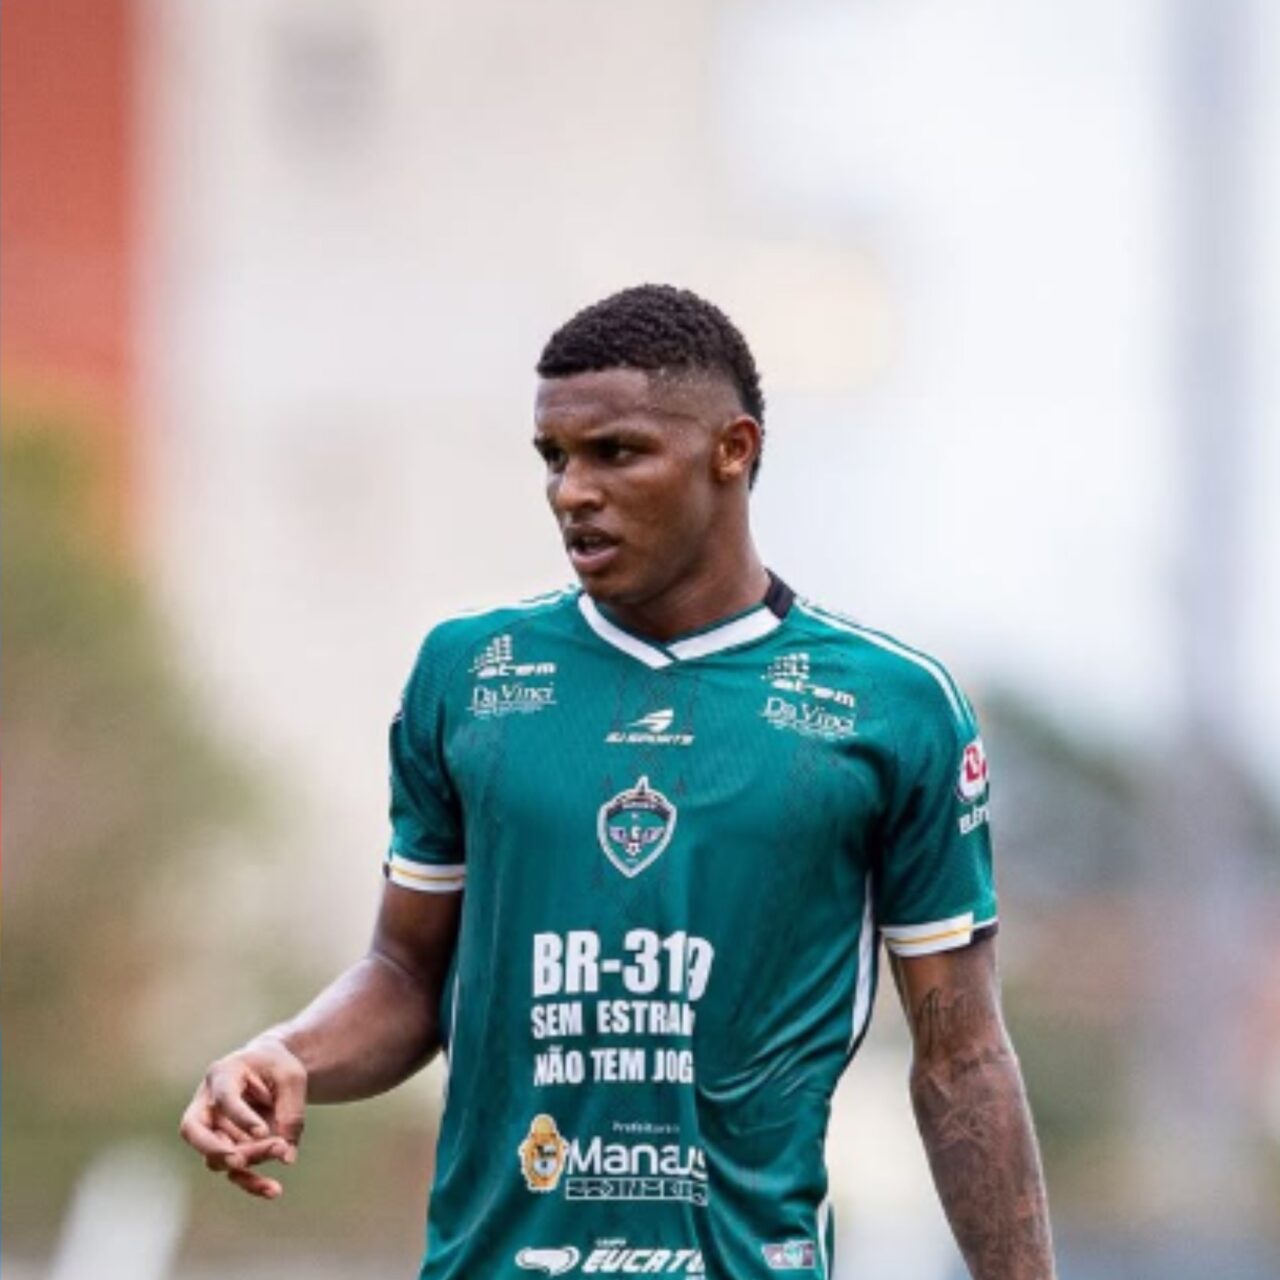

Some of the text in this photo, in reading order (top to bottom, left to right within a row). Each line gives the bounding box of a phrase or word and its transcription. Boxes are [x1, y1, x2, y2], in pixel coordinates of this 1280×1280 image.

[531, 1000, 695, 1039] SEM ESTRA
[533, 1045, 695, 1087] NÃO TEM JOG
